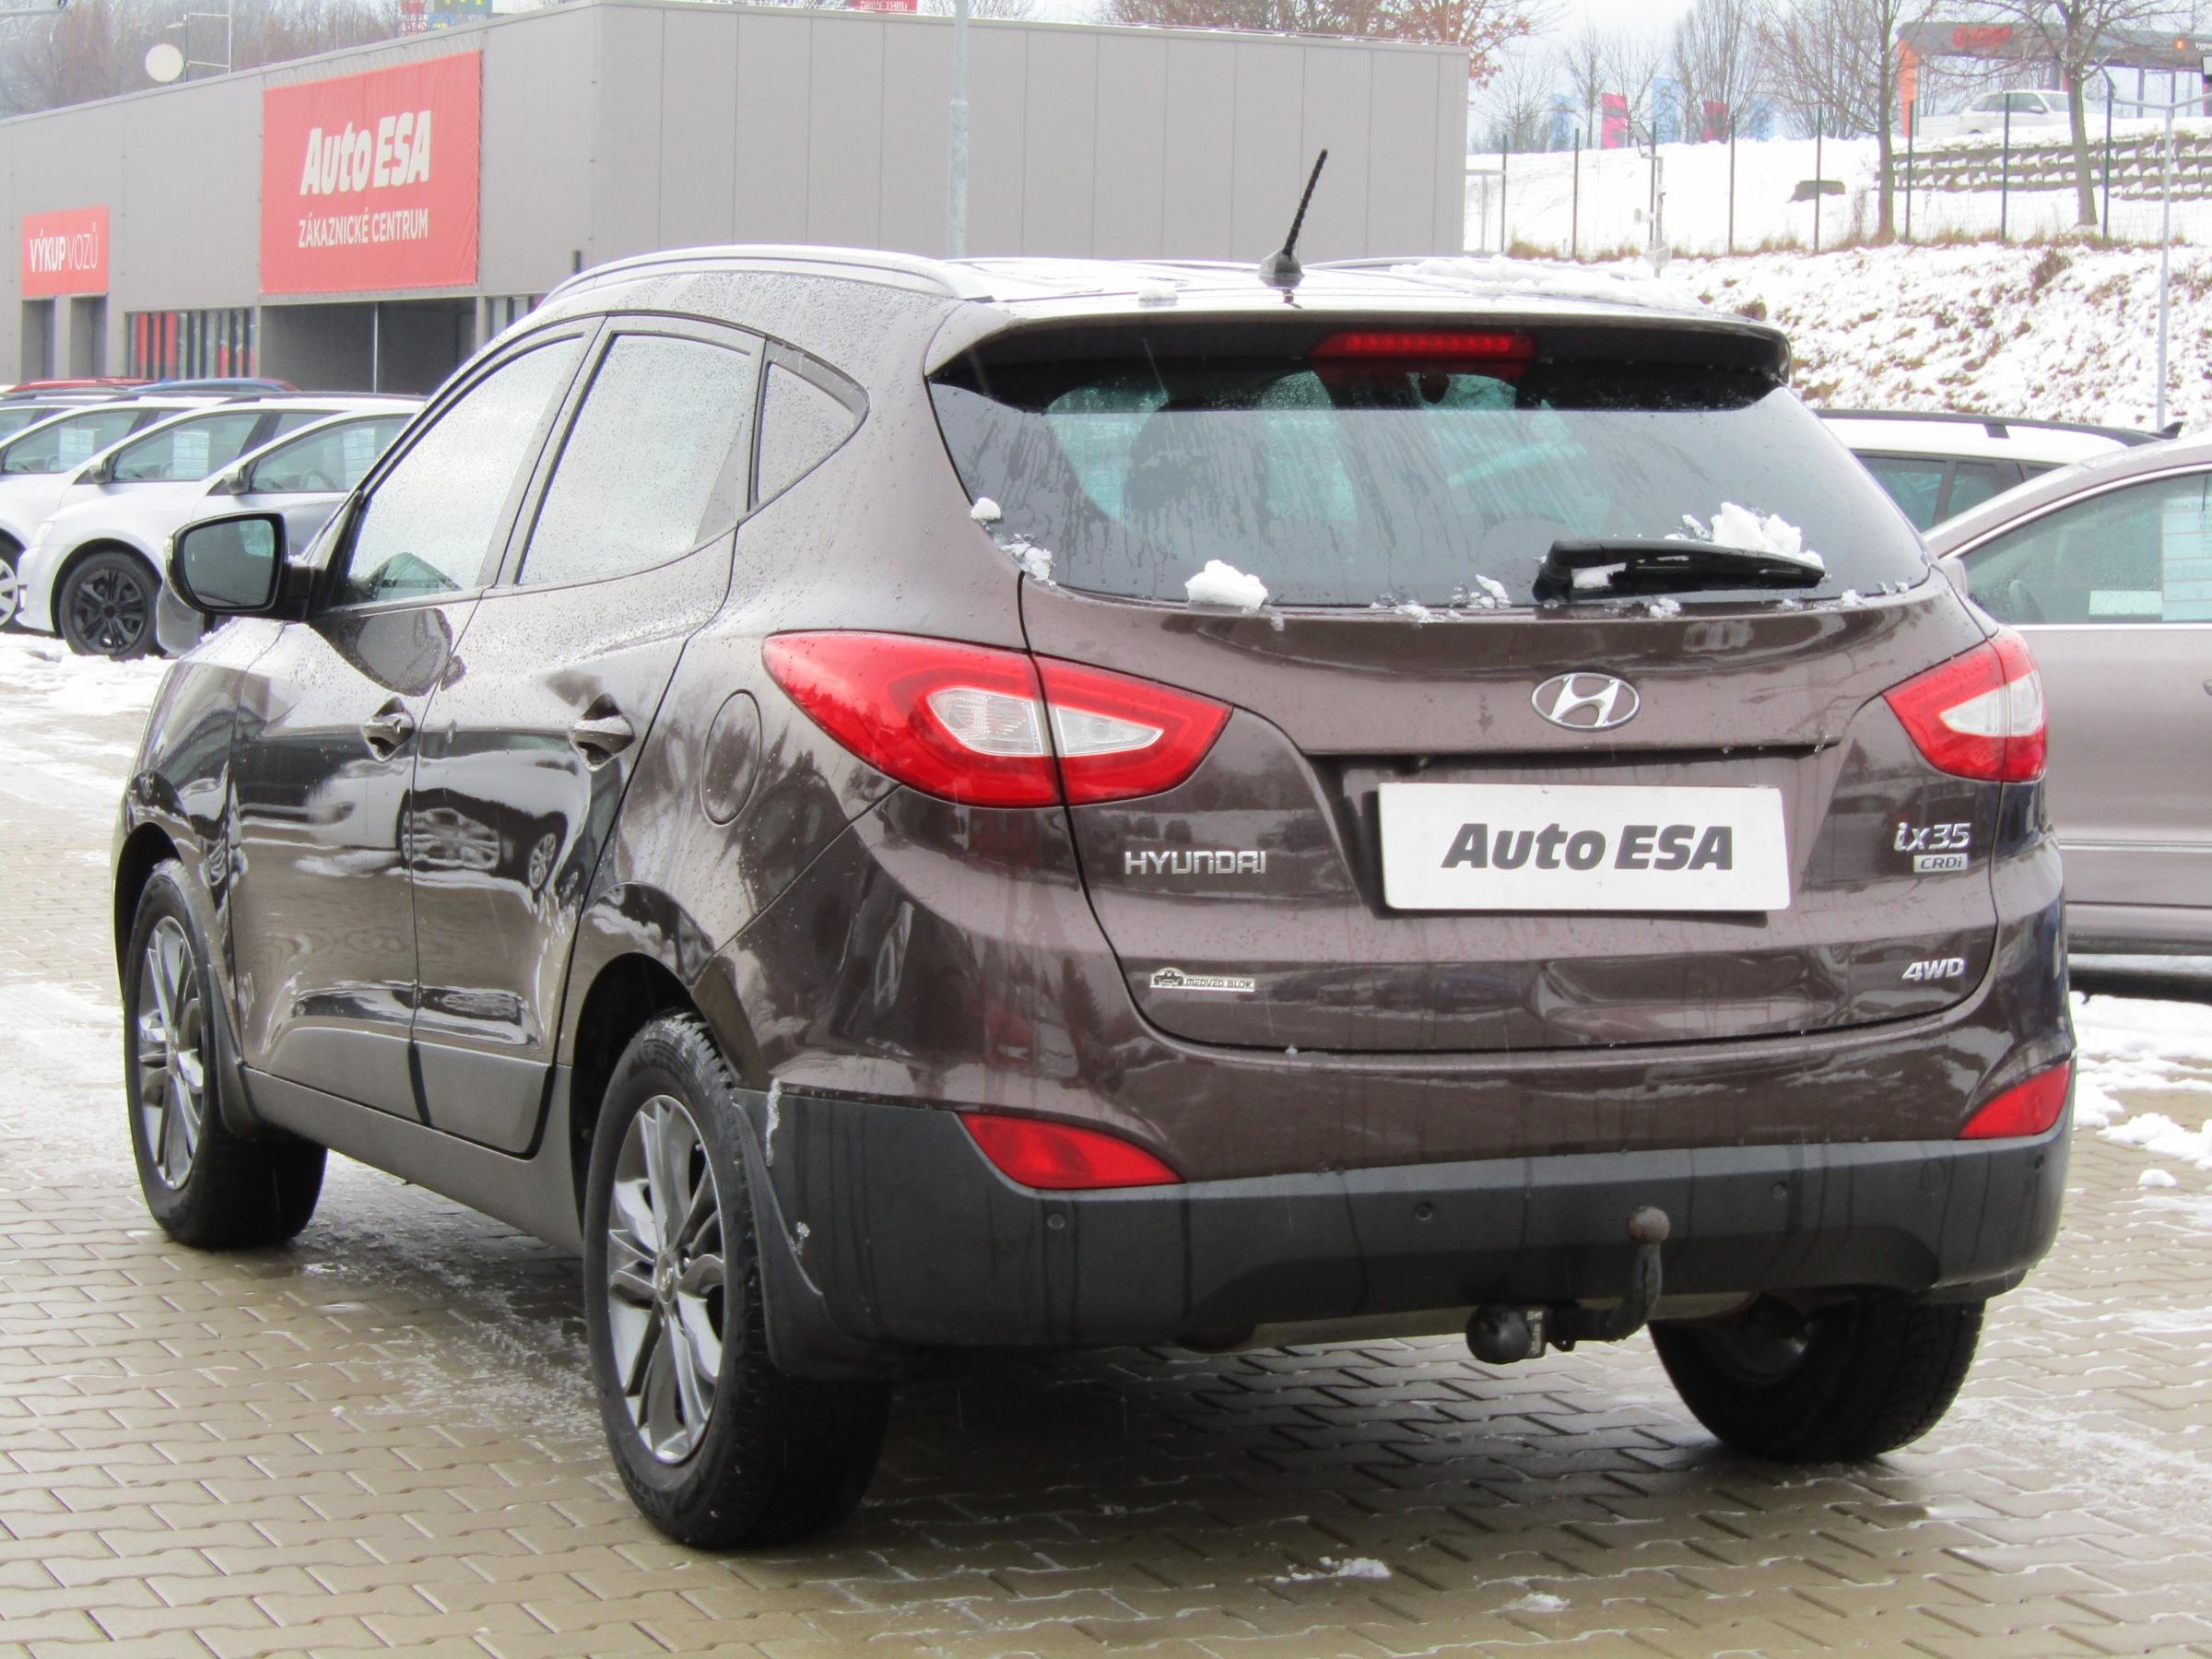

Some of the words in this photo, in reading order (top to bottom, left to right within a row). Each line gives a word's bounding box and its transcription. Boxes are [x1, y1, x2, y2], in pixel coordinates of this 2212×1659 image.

[300, 121, 372, 196] Auto
[373, 110, 431, 188] ESA
[298, 206, 370, 249] ZÁKAZNICKÉ
[371, 207, 429, 243] CENTRUM
[29, 228, 66, 273] VÝKUP
[66, 221, 99, 271] VOZŮ
[1440, 823, 1606, 871] Auto
[1614, 824, 1734, 871] ESA
[1893, 821, 1972, 852] ix35
[1124, 851, 1266, 875] HYUNDAI
[1920, 855, 1964, 871] CRDi
[1228, 980, 1253, 989] BLOK
[1901, 958, 1965, 982] 4WD
